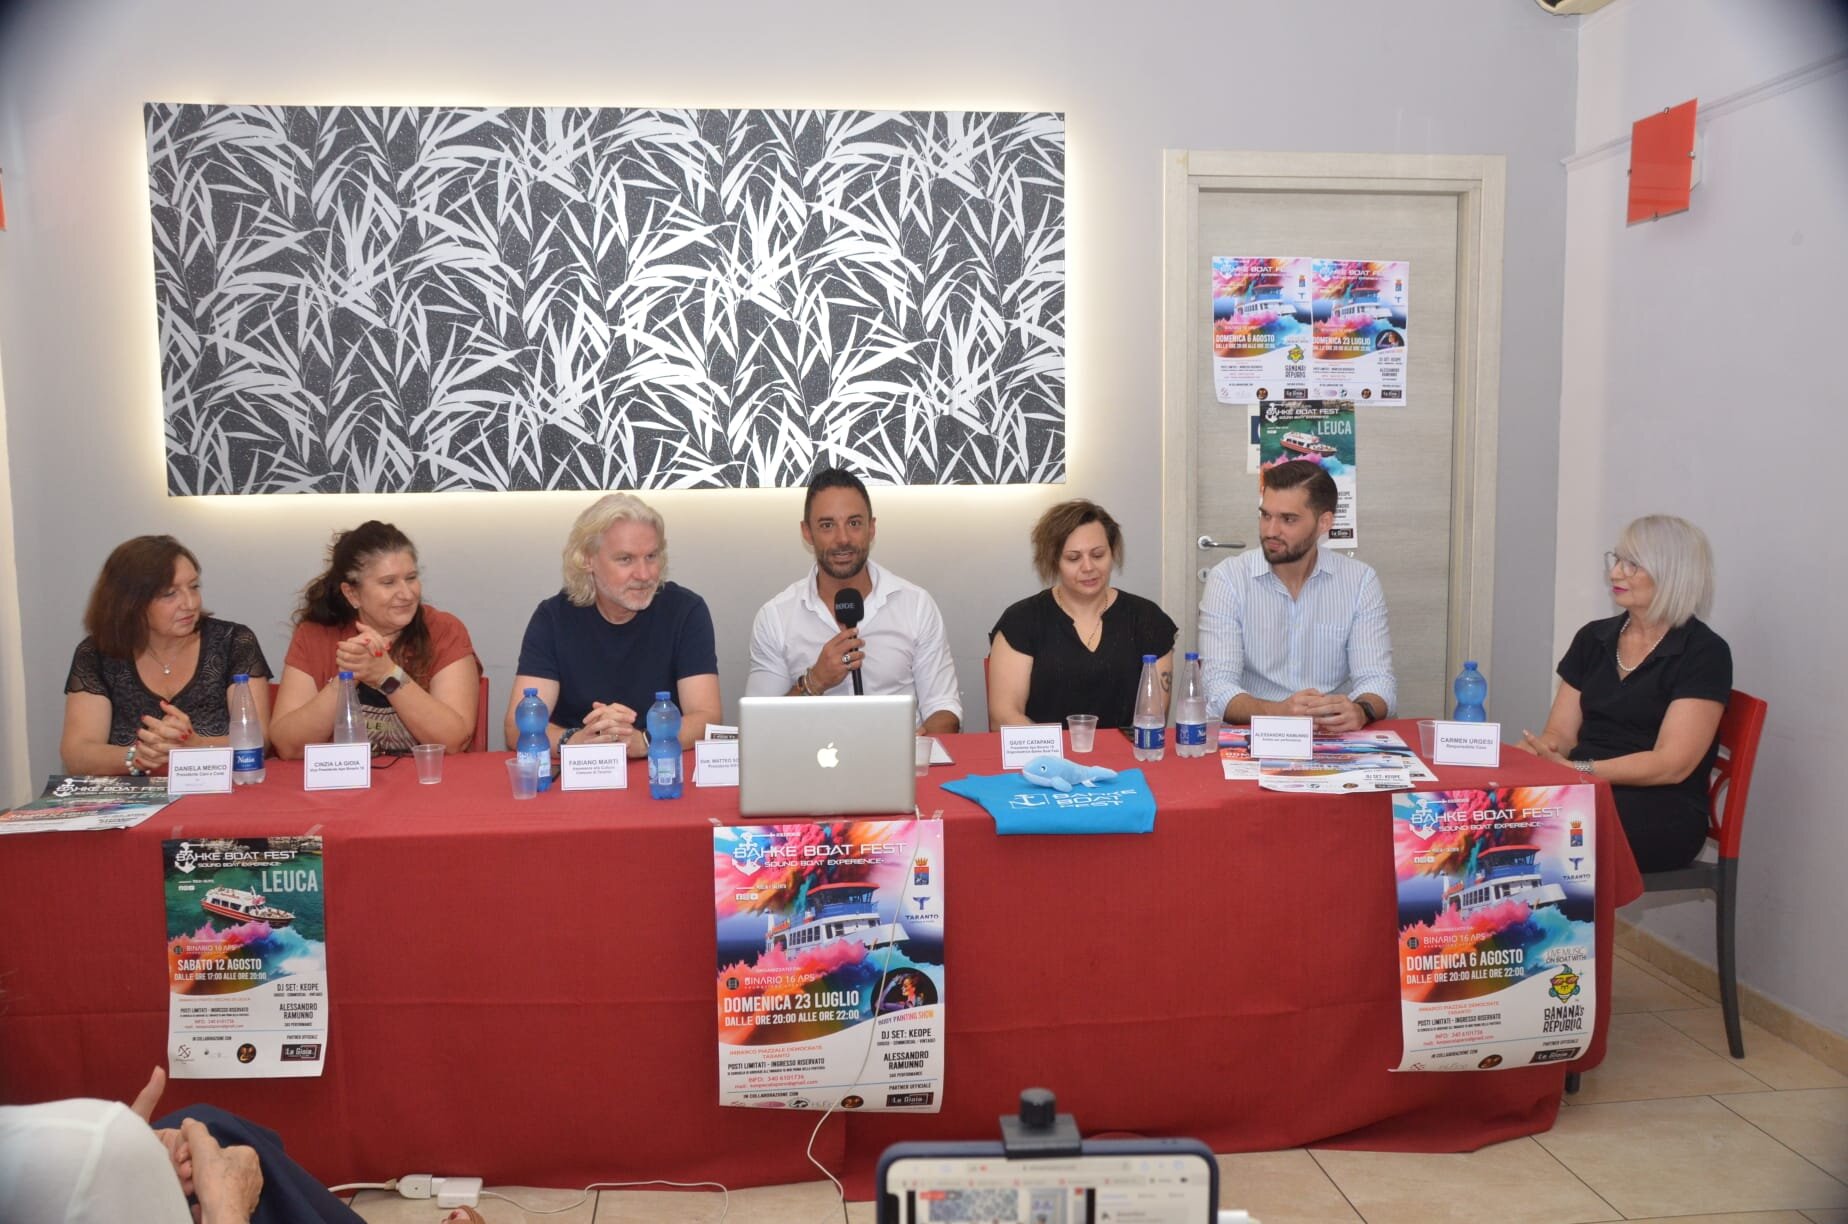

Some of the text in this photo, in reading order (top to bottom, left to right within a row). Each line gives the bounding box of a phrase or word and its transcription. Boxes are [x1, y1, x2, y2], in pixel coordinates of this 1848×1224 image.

[1253, 334, 1275, 342] AGOSTO
[1317, 420, 1352, 435] LEUCA
[1411, 807, 1563, 824] BAHKE BOAT FEST
[1438, 824, 1469, 832] SOUND
[175, 850, 298, 861] BAHKE BOAT FEST
[734, 843, 907, 858] BAHKE BOAT FEST
[262, 869, 318, 893] LEUCA
[1563, 873, 1591, 881] TARANTO
[1423, 936, 1457, 945] BINARIO
[177, 957, 262, 970] SABATO 12 AGOSTO
[1406, 948, 1524, 971] DOMENICA 6 AGOSTO
[744, 974, 816, 985] BINARIO 16 APS
[1406, 966, 1525, 984] DALLE ORE 20:00 ALLE ORE 22:00
[286, 983, 298, 991] SET:
[300, 983, 319, 991] KEOPE
[279, 1003, 317, 1011] ALESSANDRO
[723, 990, 860, 1013] DOMENICA 23 LUGLIO
[283, 1011, 314, 1019] RAMUNNO
[725, 1009, 860, 1026] DALLE ORE 20:00 ALLE ORE 22:00
[881, 1028, 932, 1040] DJ SET: KEOPE
[884, 1051, 929, 1061] ALESSANDRO
[888, 1060, 924, 1070] RAMUNNO
